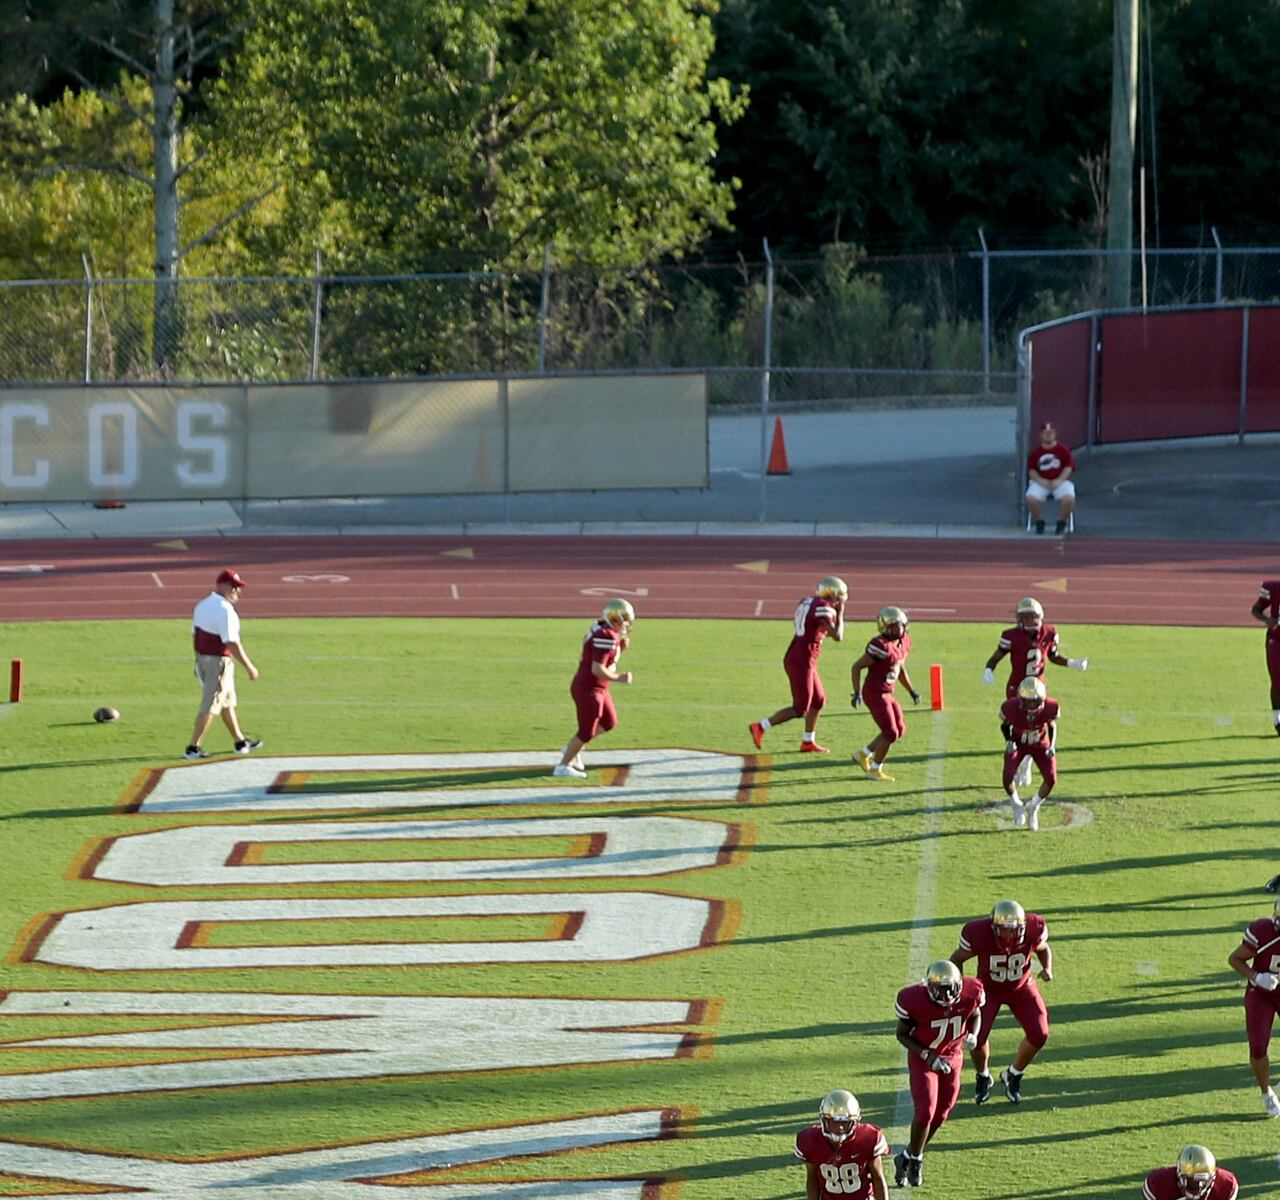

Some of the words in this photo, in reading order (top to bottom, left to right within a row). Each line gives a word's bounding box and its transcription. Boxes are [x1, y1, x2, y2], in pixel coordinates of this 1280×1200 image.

[990, 953, 1026, 982] 58
[930, 1016, 963, 1049] 71
[820, 1163, 861, 1194] 88
